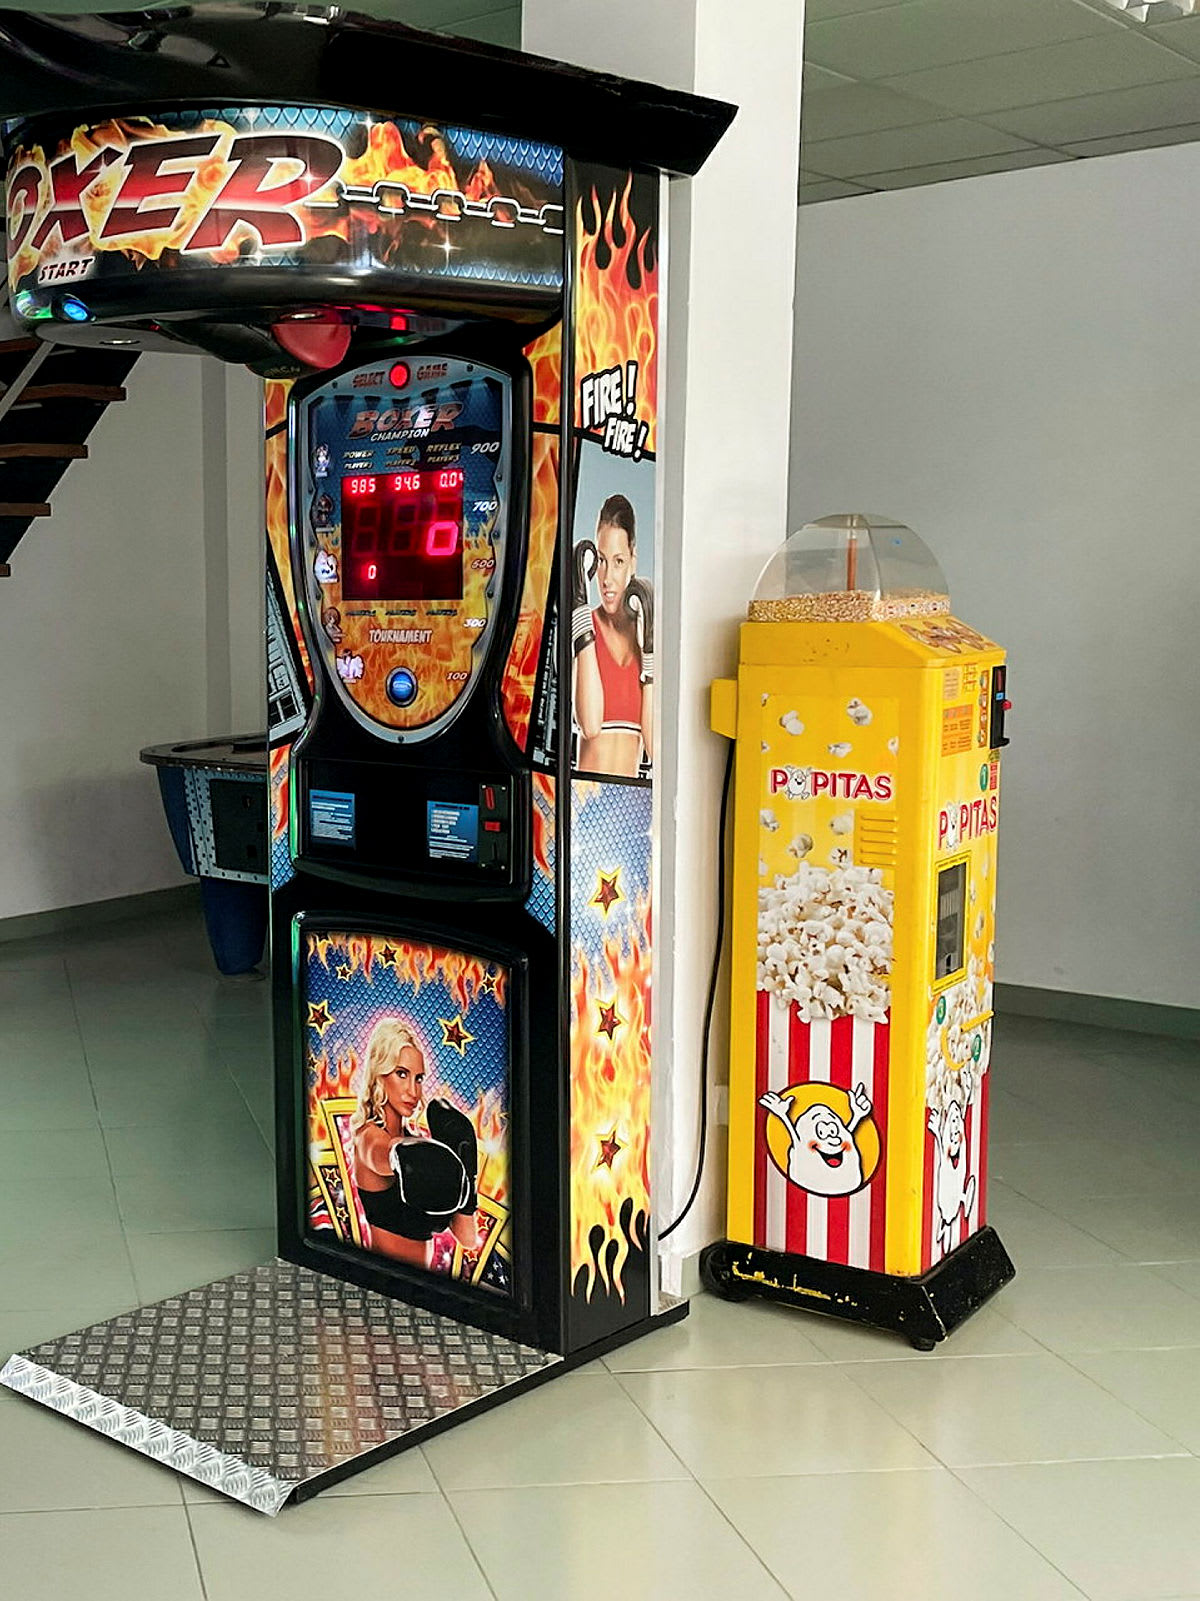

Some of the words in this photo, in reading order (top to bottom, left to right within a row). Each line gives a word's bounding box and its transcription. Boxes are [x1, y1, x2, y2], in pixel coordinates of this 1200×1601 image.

[39, 256, 95, 281] START
[353, 371, 385, 388] SELECT
[582, 362, 638, 429] FIRE!
[349, 402, 463, 439] BOXER
[370, 428, 430, 442] CHAMPION
[604, 417, 648, 458] FIRE!
[343, 451, 374, 459] POWER
[386, 445, 417, 455] SPEED
[425, 442, 462, 454] REFLEX
[471, 442, 500, 455] 900
[351, 478, 376, 494] 985
[394, 475, 421, 491] 946
[472, 501, 498, 512] 700
[426, 521, 459, 556] 0
[368, 564, 377, 580] 0
[463, 617, 486, 628] 300
[369, 629, 432, 644] TOURNAMENT
[446, 670, 468, 681] 100
